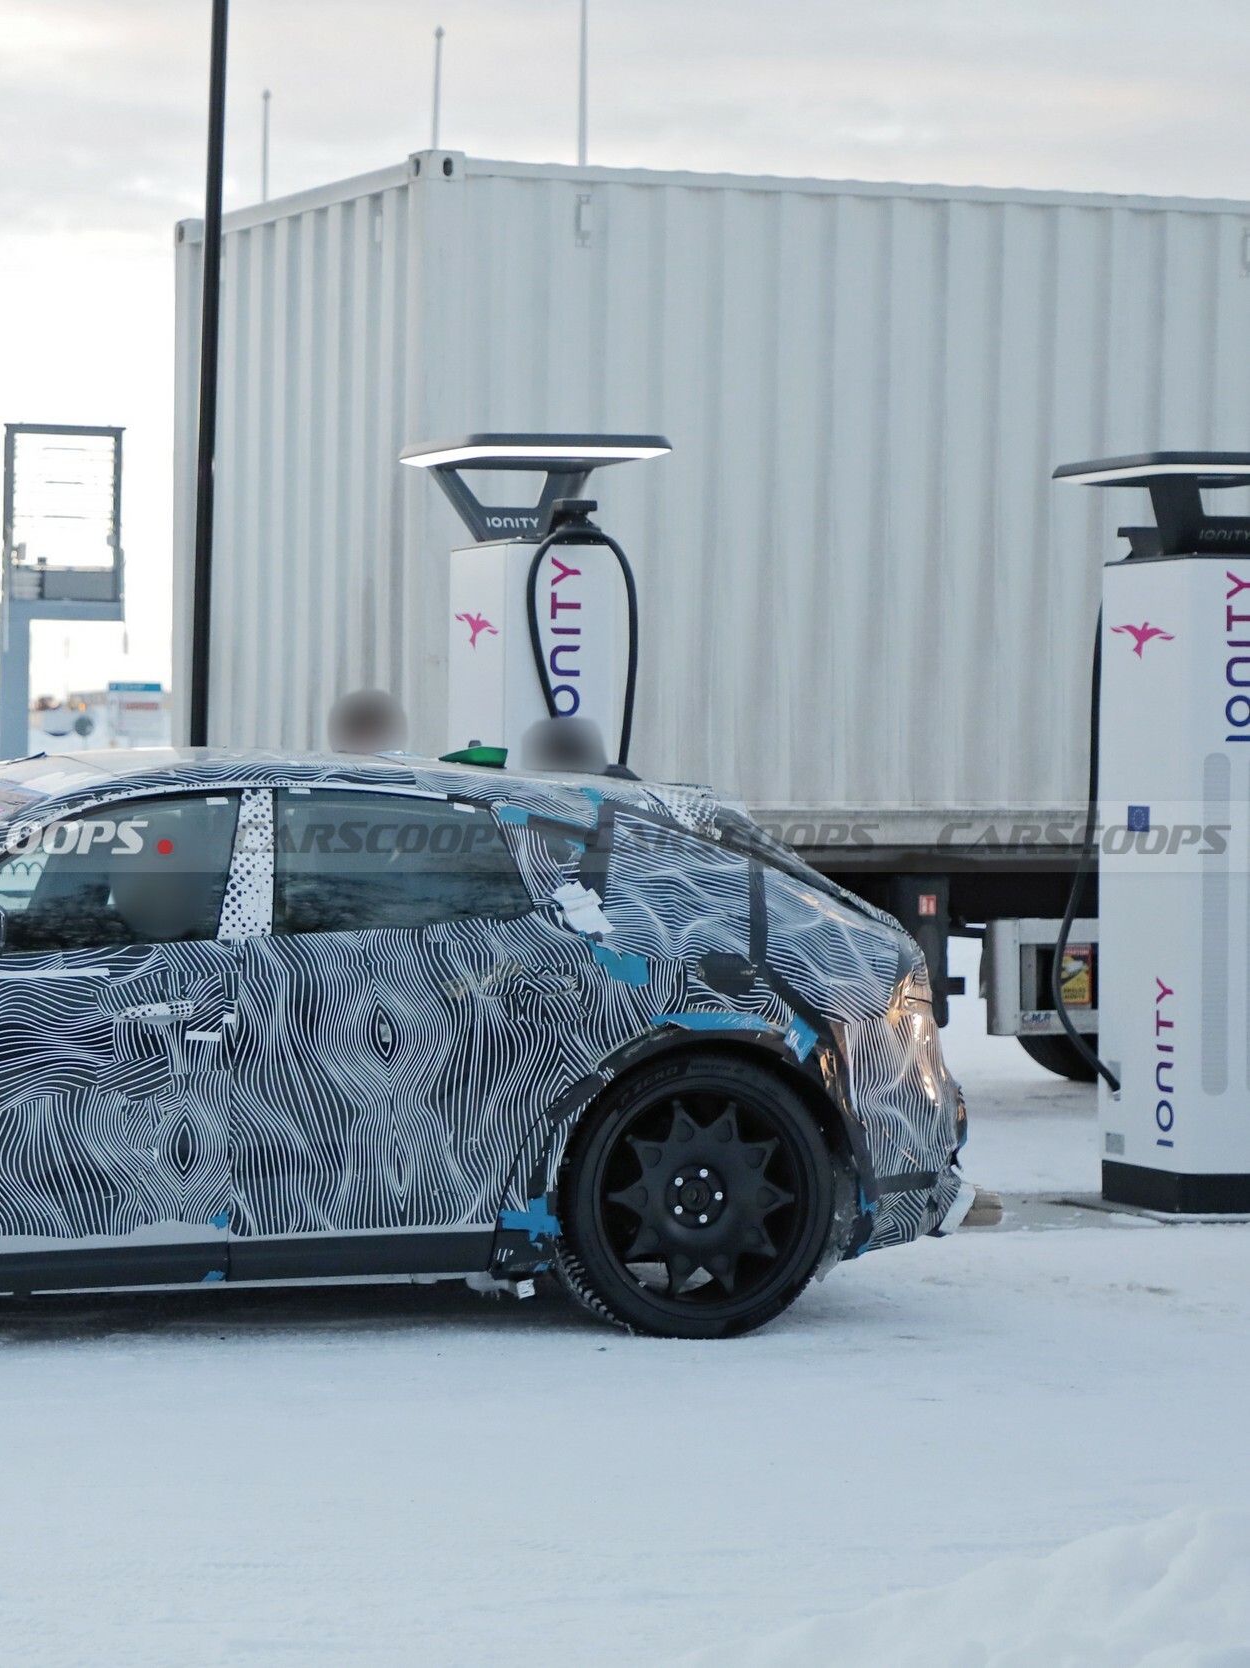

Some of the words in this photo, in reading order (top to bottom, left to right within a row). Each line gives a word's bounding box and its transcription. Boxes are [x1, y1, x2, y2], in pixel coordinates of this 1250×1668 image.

[486, 517, 539, 529] IONITY
[549, 556, 582, 718] ONITY
[1155, 976, 1175, 1148] IONITY
